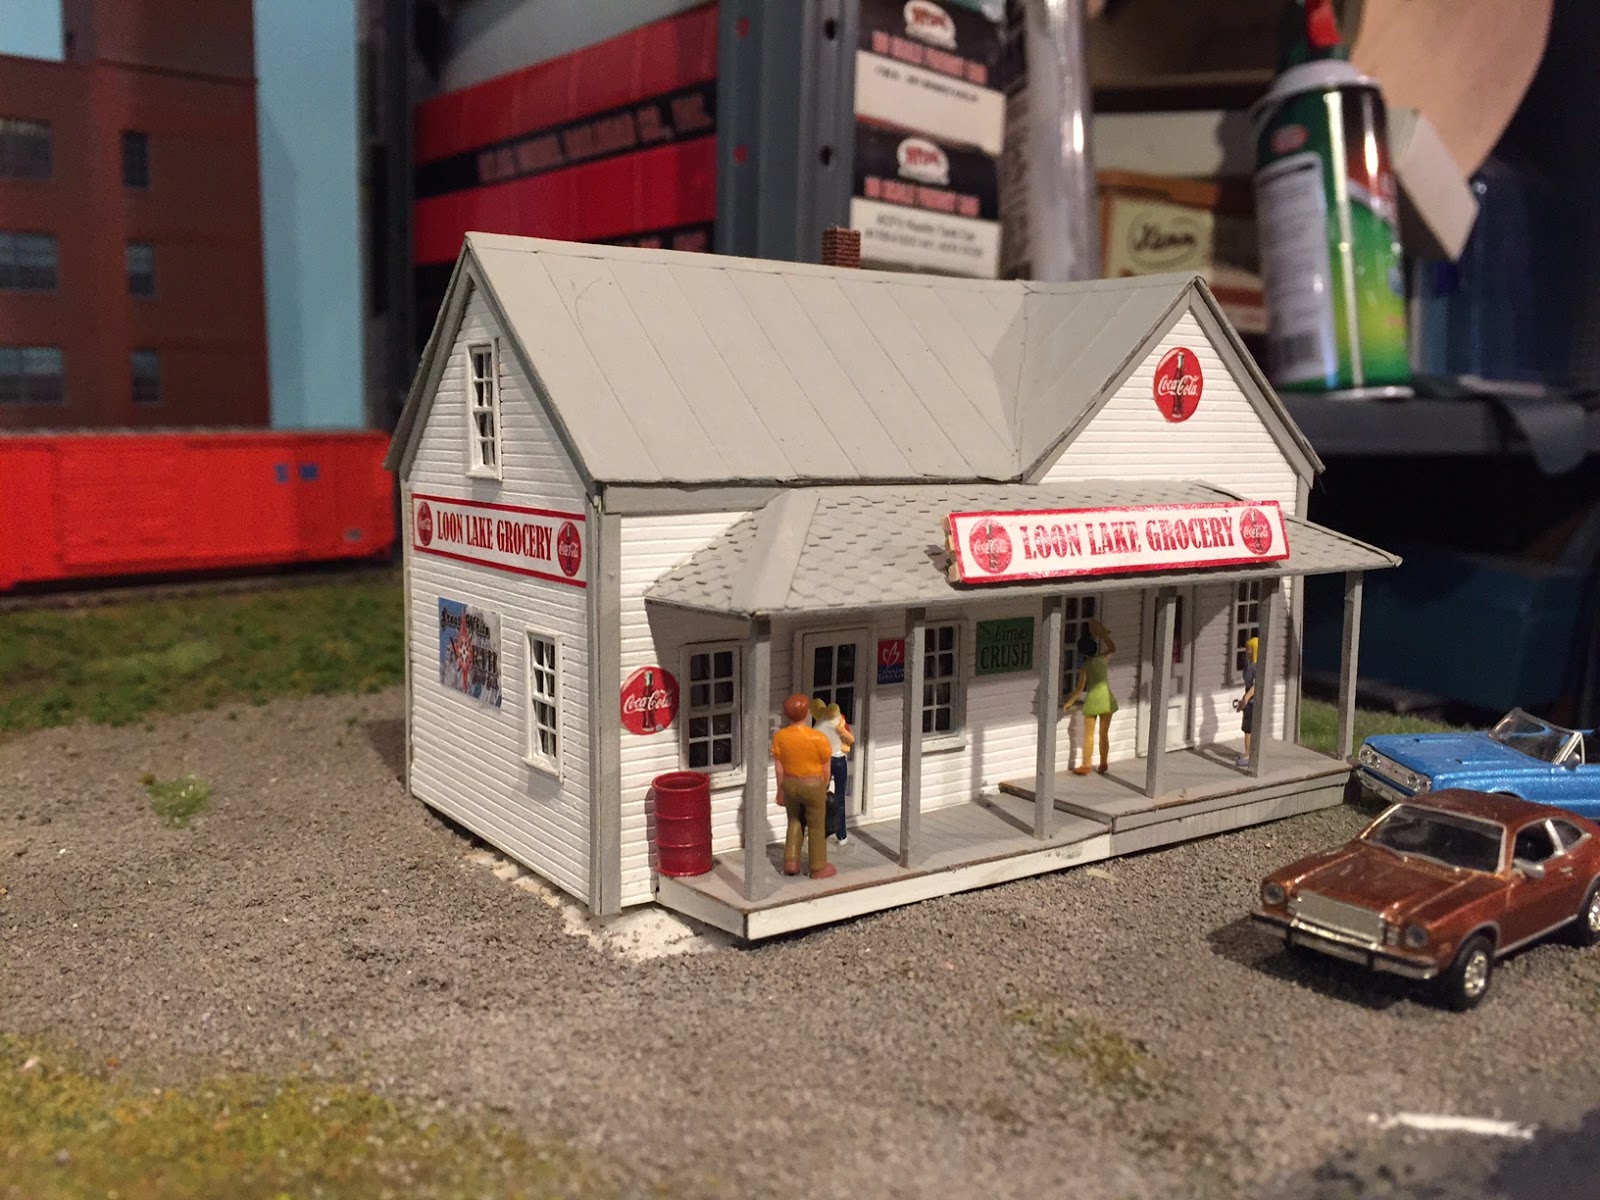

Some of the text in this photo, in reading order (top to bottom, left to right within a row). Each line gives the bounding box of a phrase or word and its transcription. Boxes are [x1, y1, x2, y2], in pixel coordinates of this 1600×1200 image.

[437, 510, 553, 562] LOON LAKE GROCERY
[1019, 516, 1236, 560] LOON LAKE GROCERY
[980, 642, 1032, 670] CRUSH
